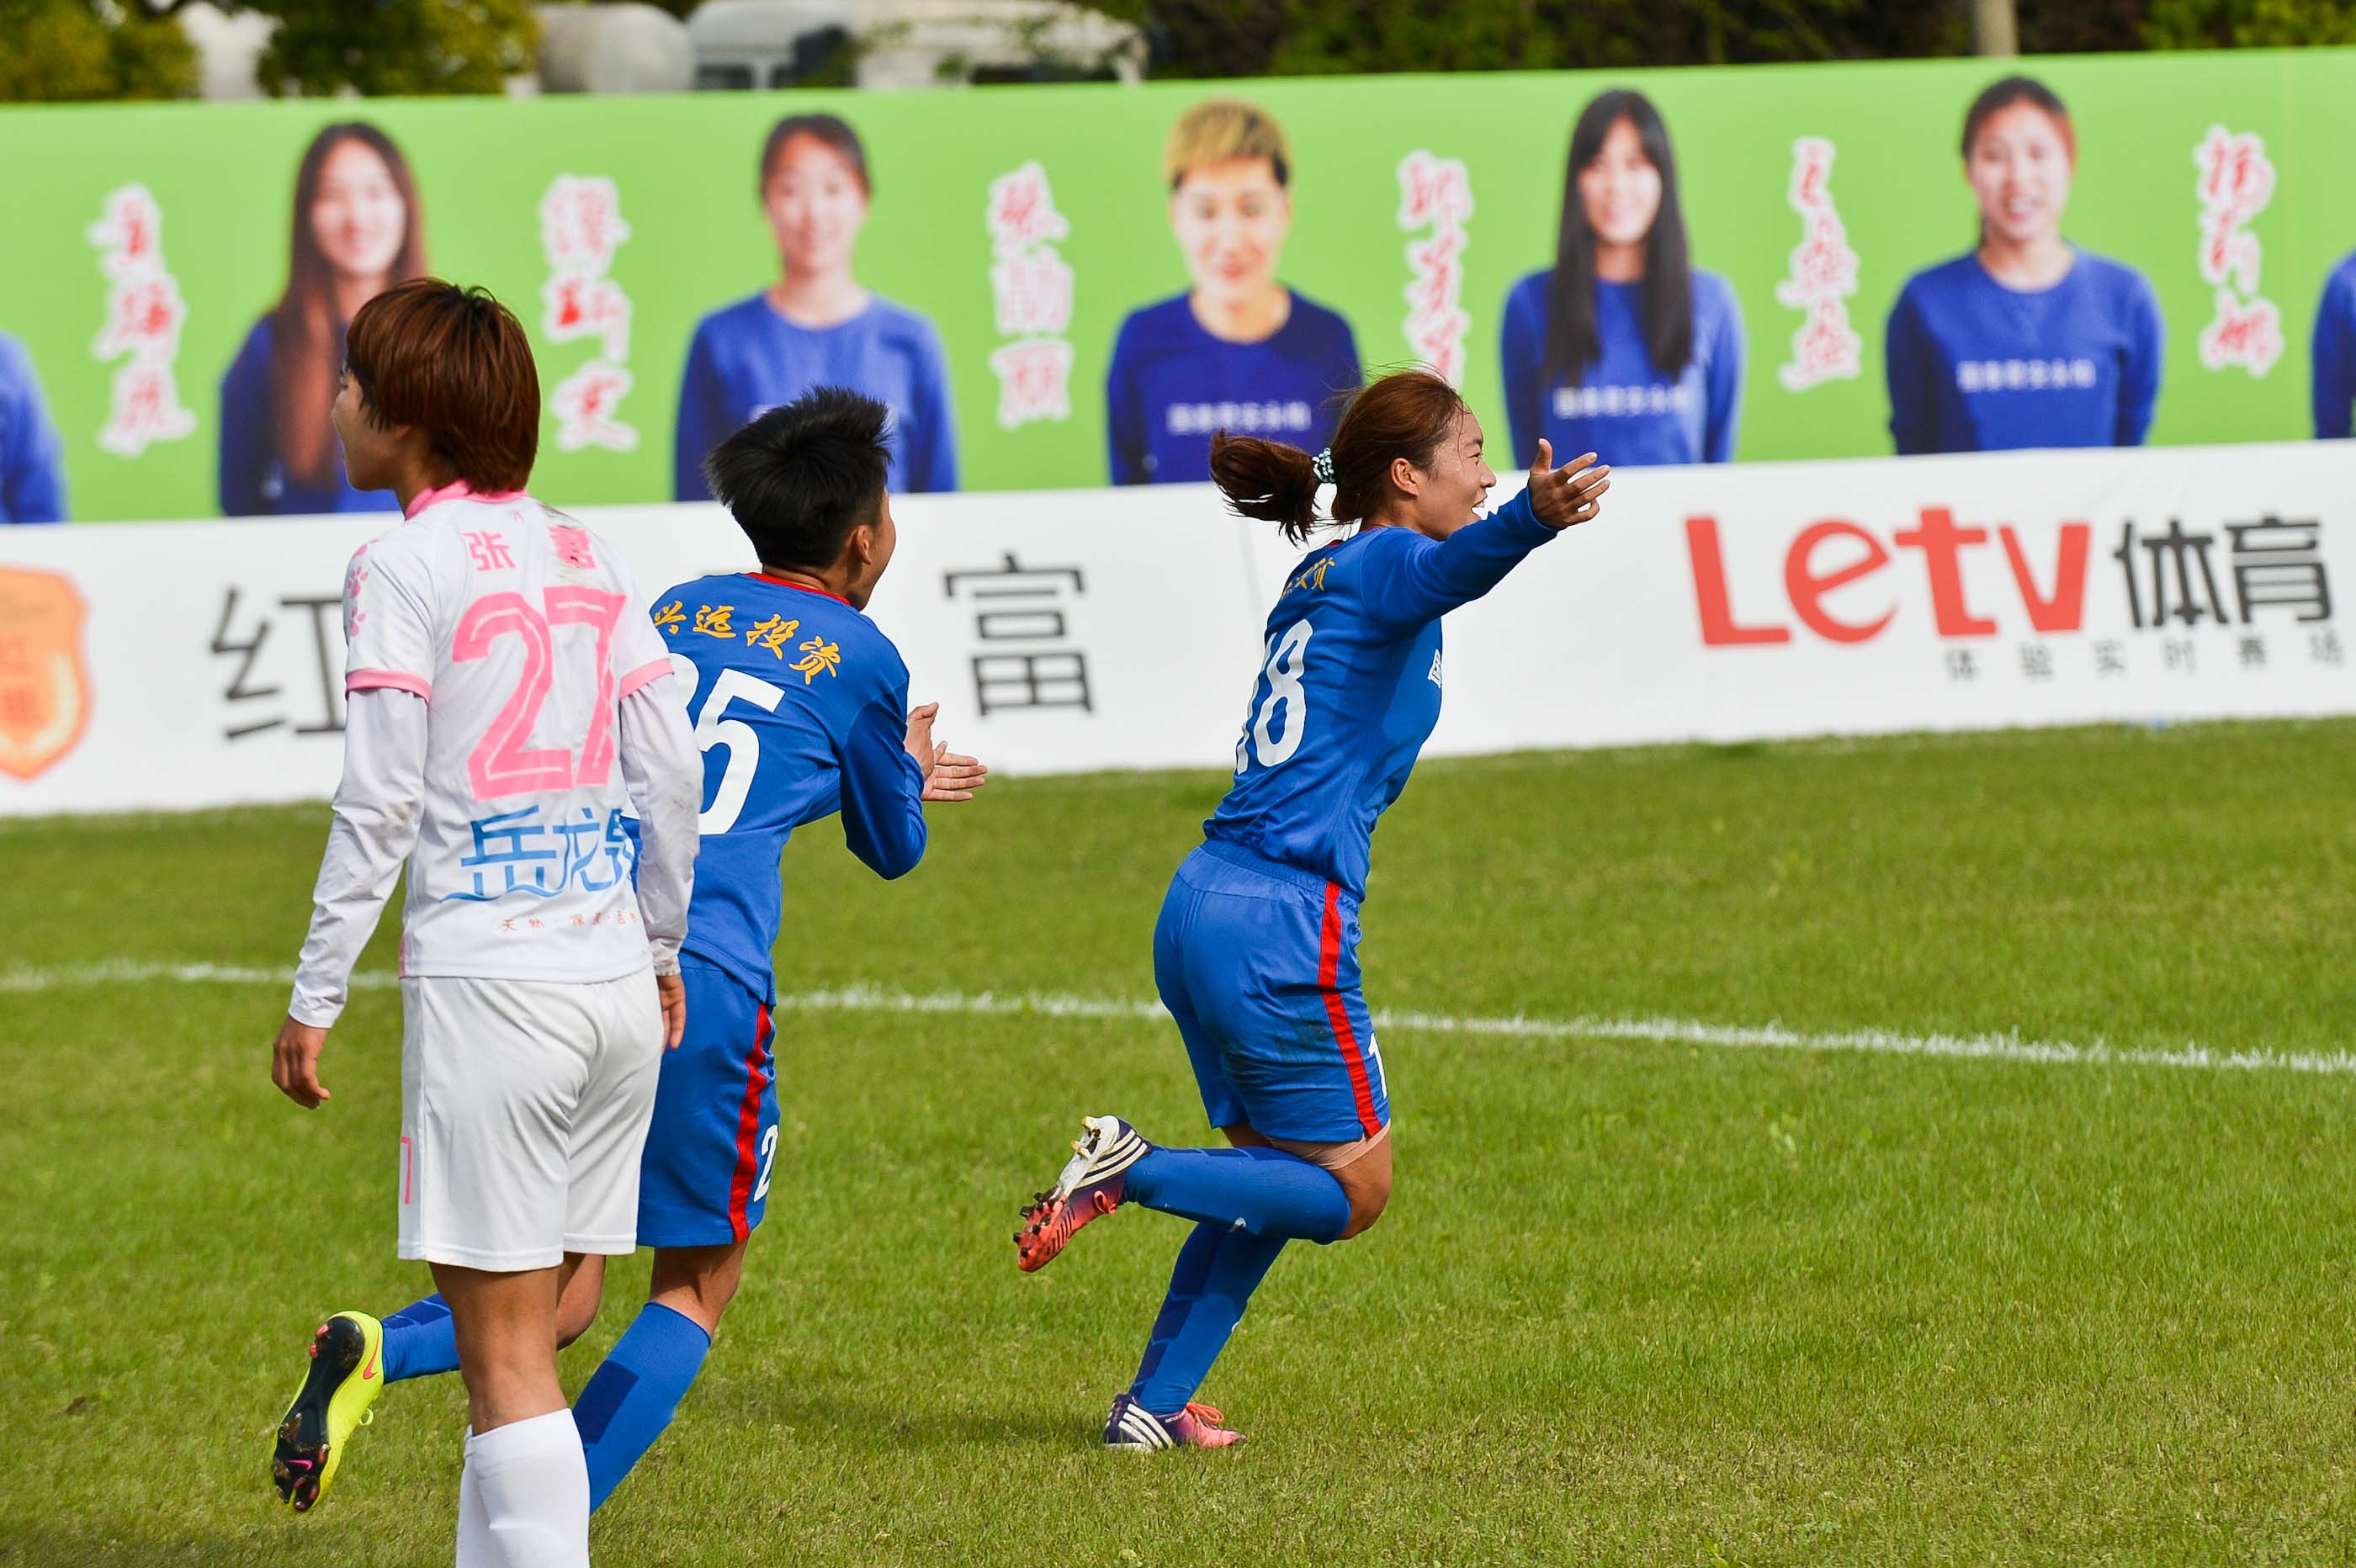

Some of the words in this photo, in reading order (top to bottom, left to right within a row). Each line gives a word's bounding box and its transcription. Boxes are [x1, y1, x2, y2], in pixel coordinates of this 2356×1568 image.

[942, 550, 1095, 721] 富
[1684, 505, 2093, 647] Letv
[2113, 514, 2336, 629] 体育
[452, 585, 627, 803] 27
[1235, 617, 1314, 776] 18
[753, 1124, 779, 1203] 2
